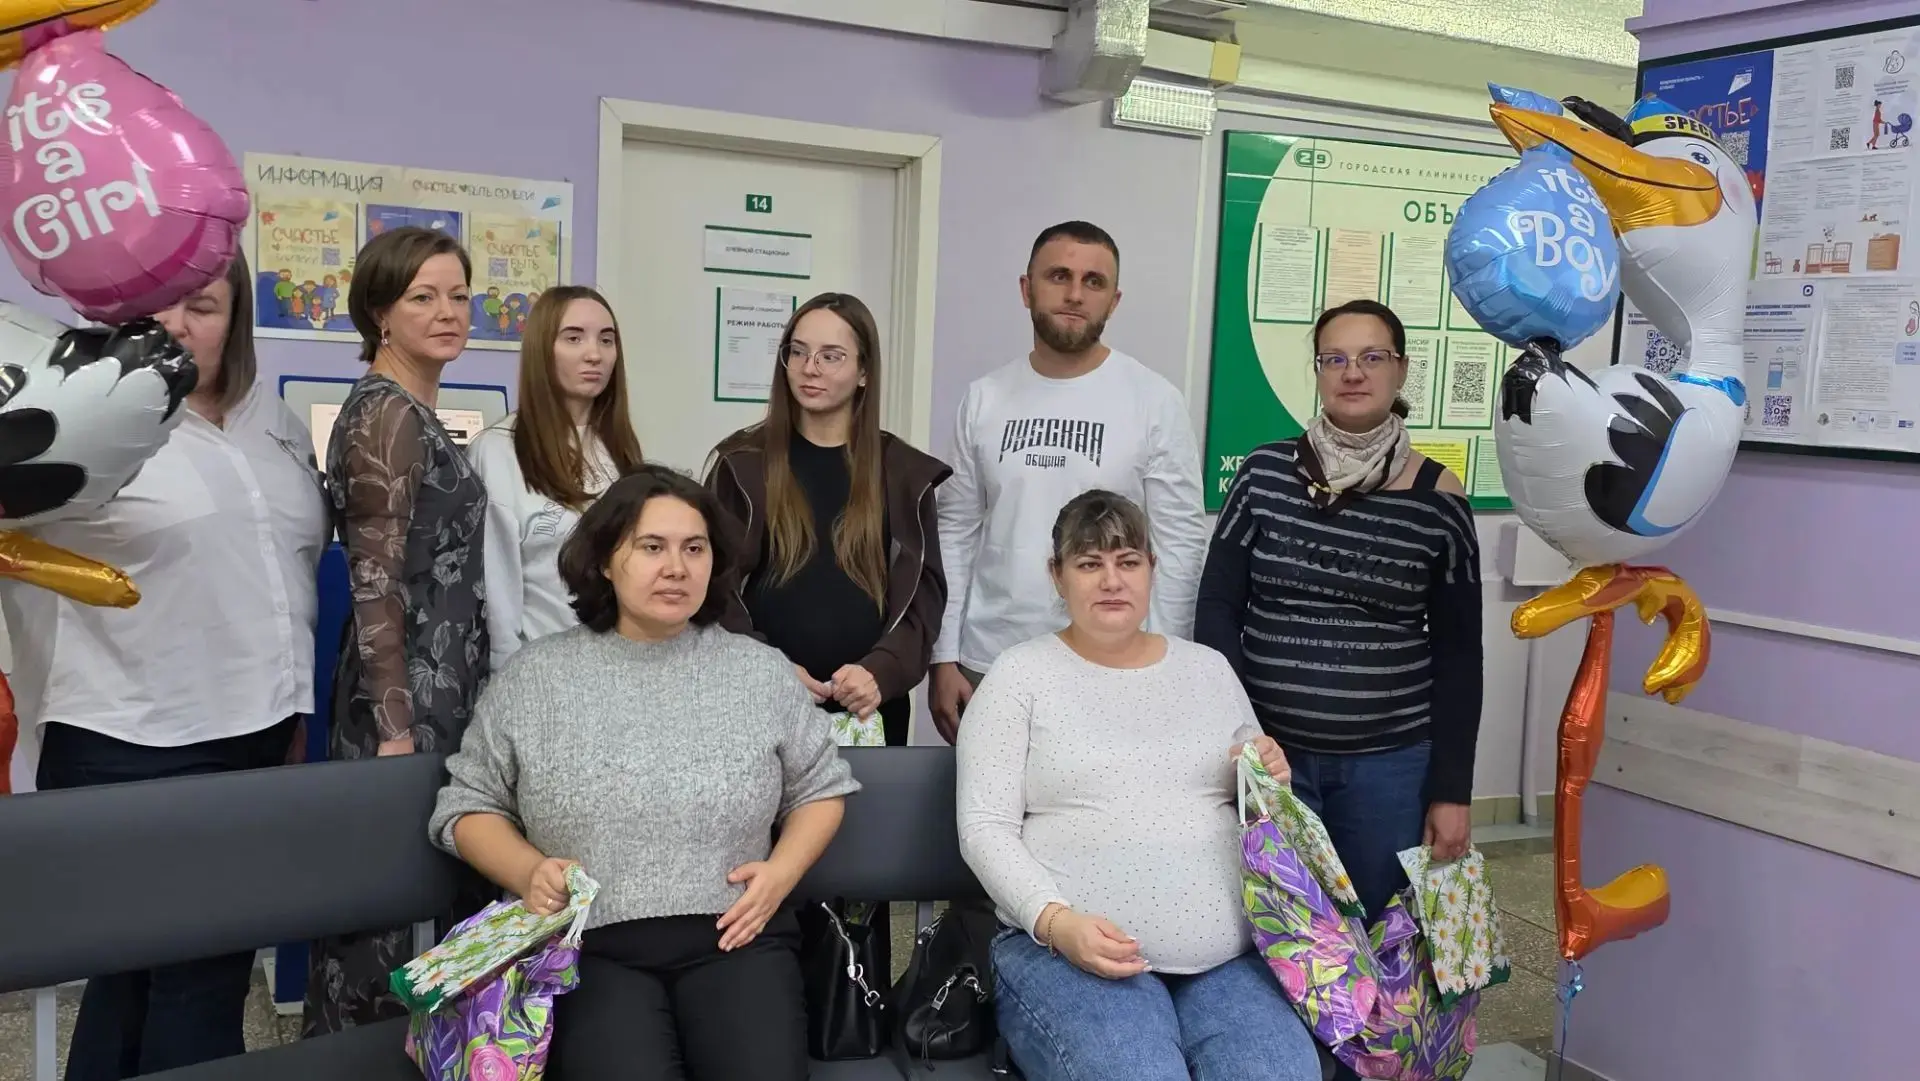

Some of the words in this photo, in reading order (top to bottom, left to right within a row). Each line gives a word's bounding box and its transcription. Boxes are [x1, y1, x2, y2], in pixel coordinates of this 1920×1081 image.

[7, 80, 112, 152] it's
[36, 141, 86, 183] a
[1339, 161, 1411, 176] ГОРОДСКАЯ
[1418, 169, 1491, 182] КЛИНИЧЕСК
[258, 164, 383, 194] ИНФОРМАЦИЯ
[1537, 168, 1608, 214] it's
[13, 161, 162, 260] Girl
[752, 197, 768, 210] 14
[272, 227, 340, 244] СЧАСТЬЕ
[1567, 203, 1596, 238] a
[1507, 210, 1618, 302] Boy
[727, 319, 755, 328] РЕЖИМ
[1025, 453, 1066, 469] ОБЩИНА
